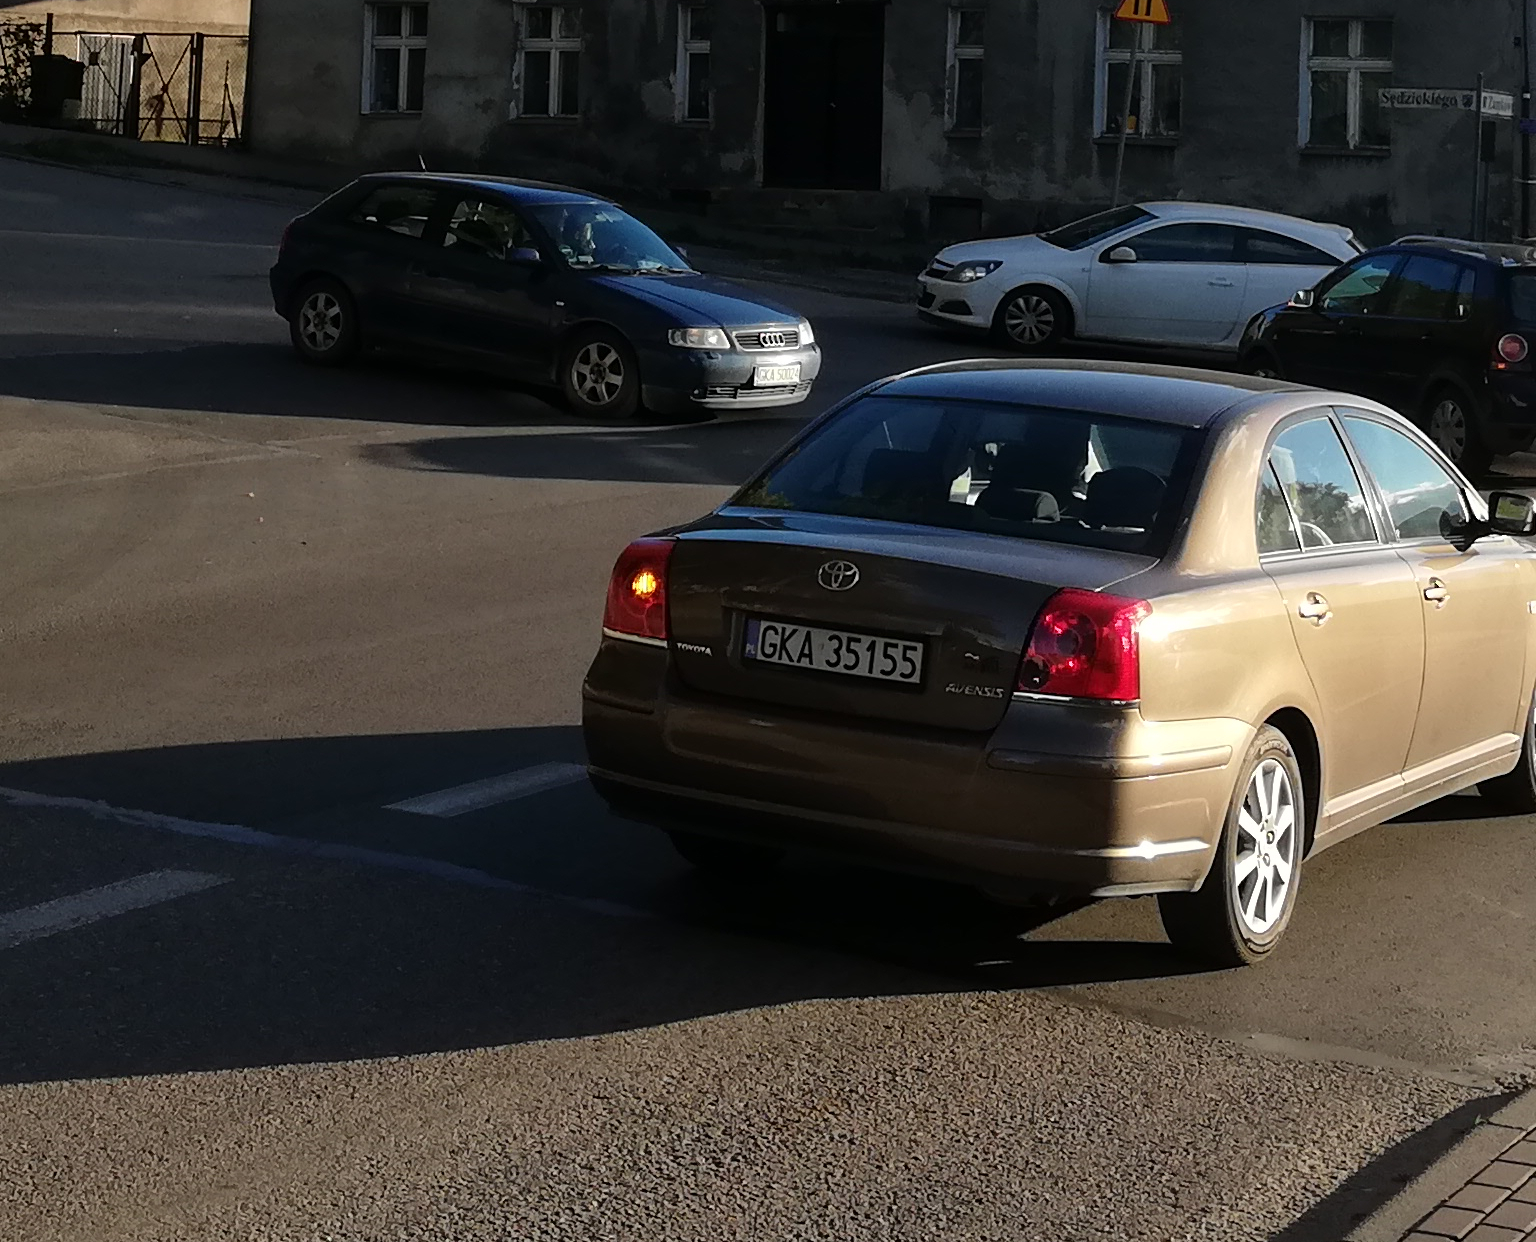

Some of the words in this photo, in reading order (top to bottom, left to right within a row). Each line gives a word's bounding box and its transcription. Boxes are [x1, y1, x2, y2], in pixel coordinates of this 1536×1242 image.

[676, 642, 713, 657] TOYOTA
[760, 625, 814, 666] GKA
[824, 634, 918, 680] 35155
[945, 682, 1005, 699] AVENSIS
